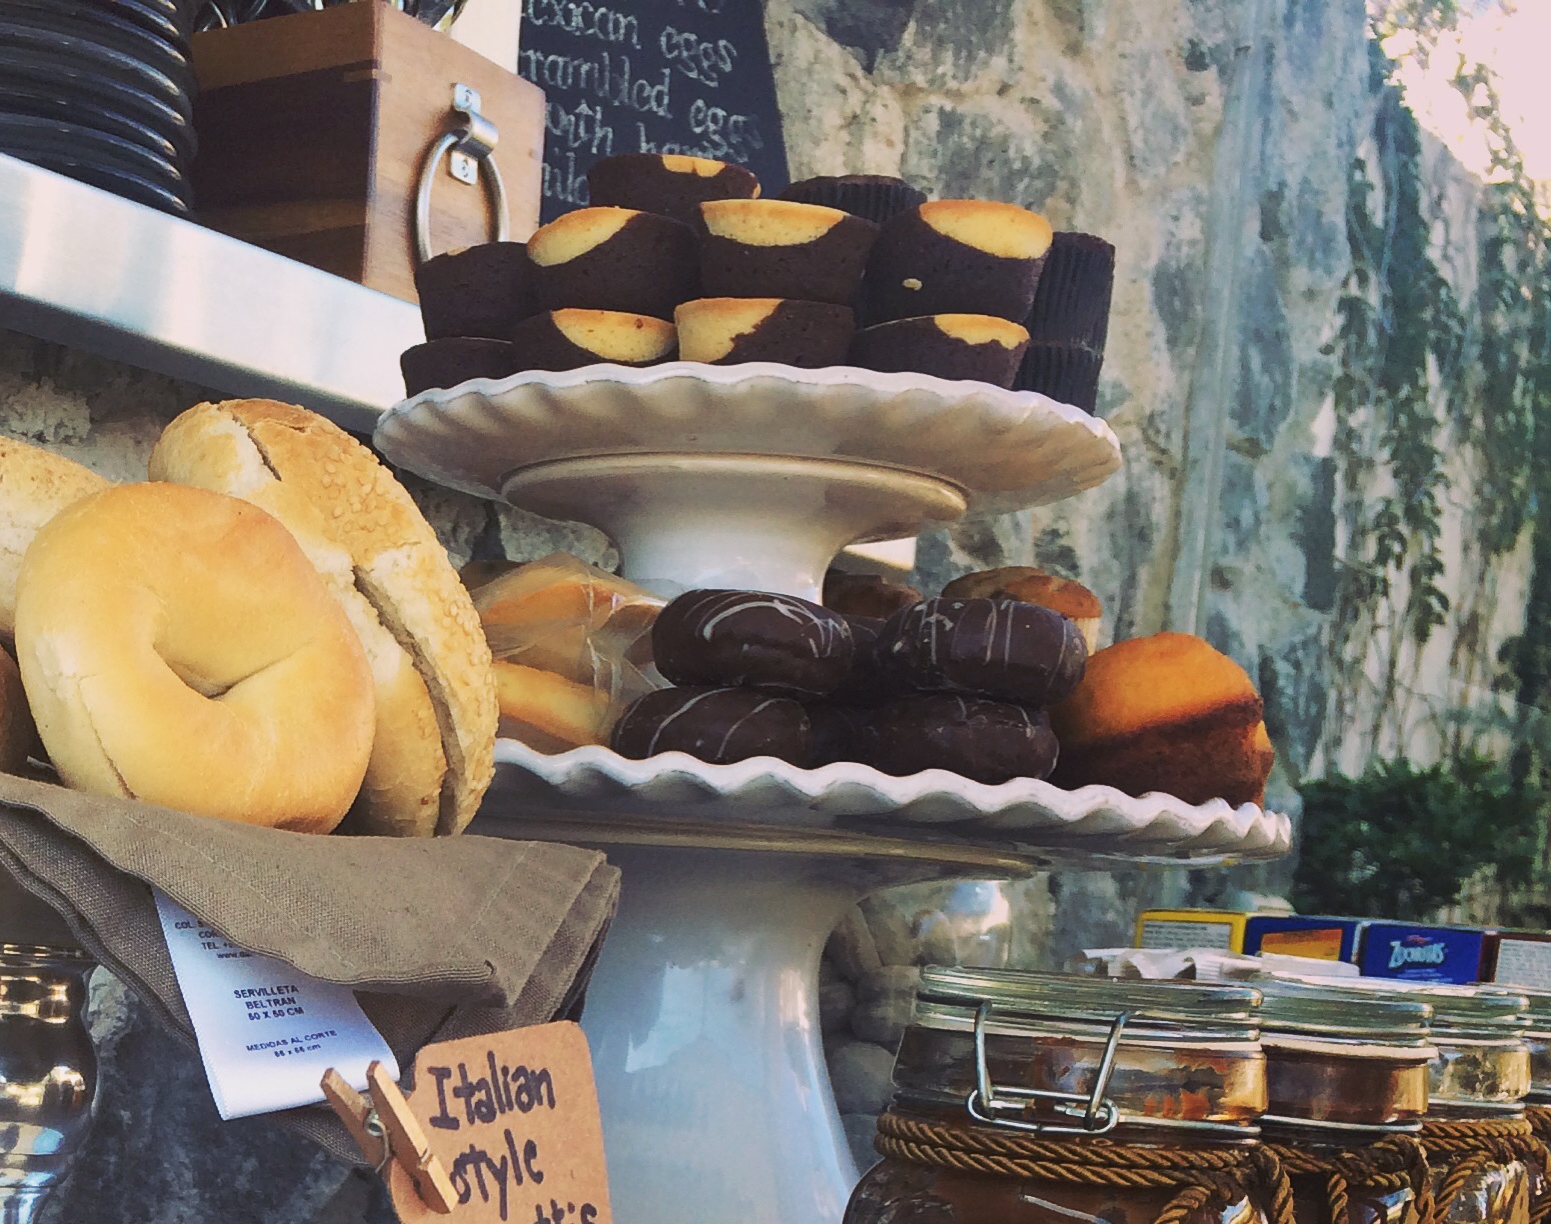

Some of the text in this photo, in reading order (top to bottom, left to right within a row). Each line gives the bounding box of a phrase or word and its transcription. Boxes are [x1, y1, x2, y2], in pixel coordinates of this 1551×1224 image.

[660, 25, 738, 88] eggs
[233, 985, 300, 999] SERVILLETA
[245, 996, 297, 1010] BELTRAN
[286, 1006, 305, 1016] CM
[304, 1030, 337, 1041] CORTE
[427, 1051, 556, 1130] Italian
[449, 1129, 544, 1222] style
